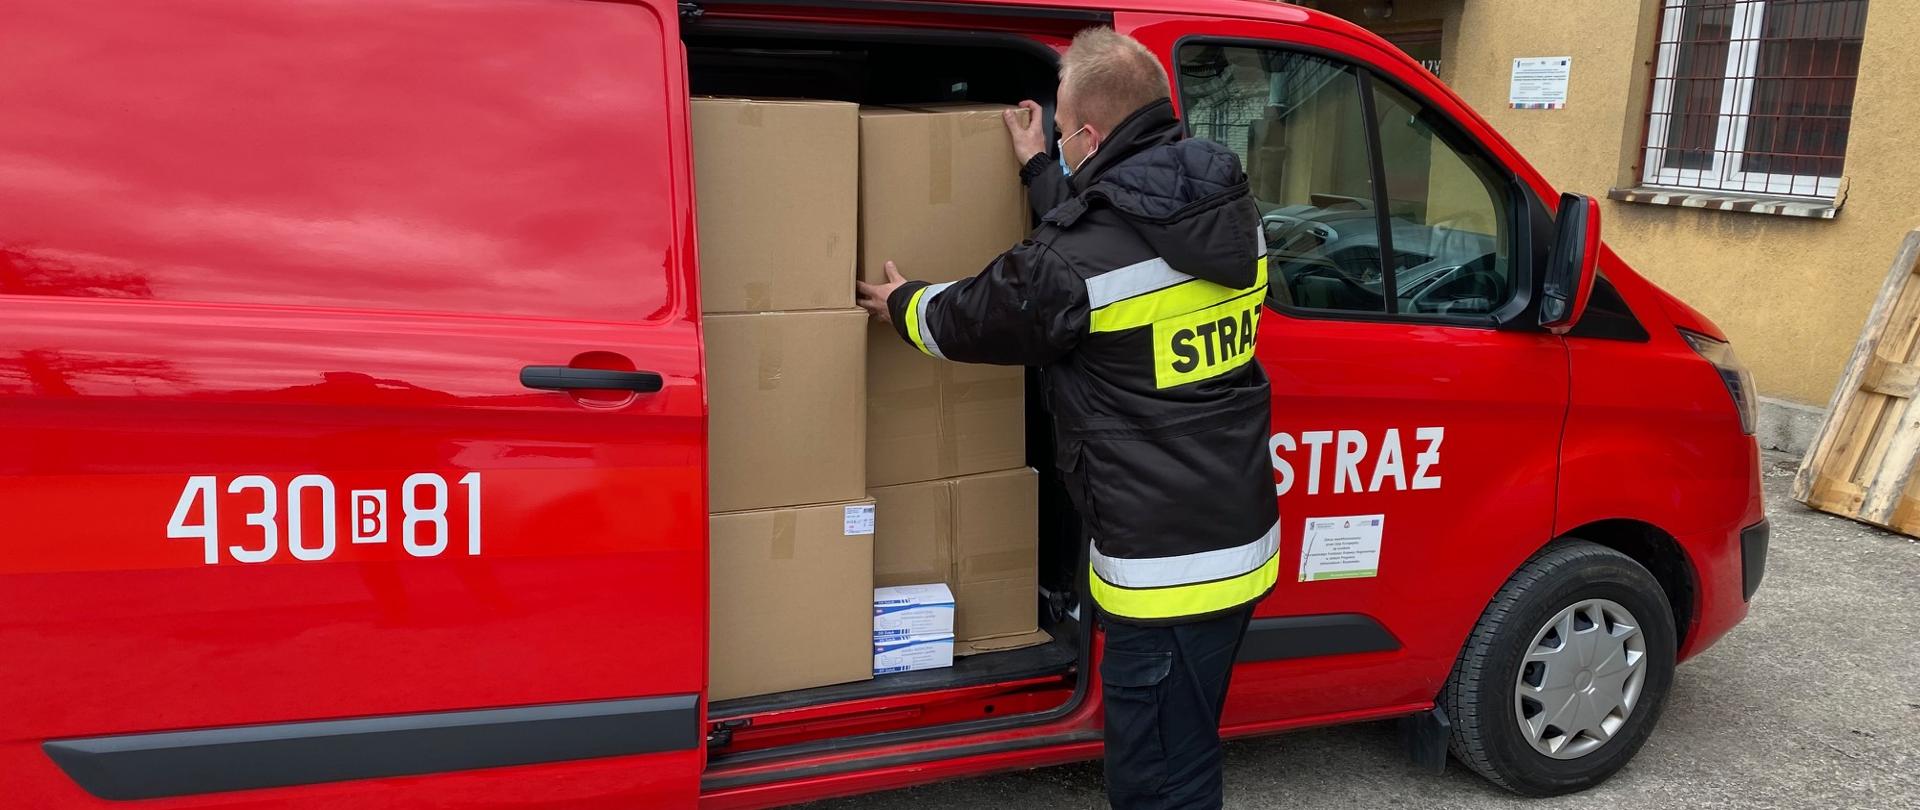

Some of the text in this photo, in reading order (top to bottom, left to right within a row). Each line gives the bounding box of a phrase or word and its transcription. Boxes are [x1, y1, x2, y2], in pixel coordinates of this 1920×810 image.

[167, 472, 481, 564] 430 B 81
